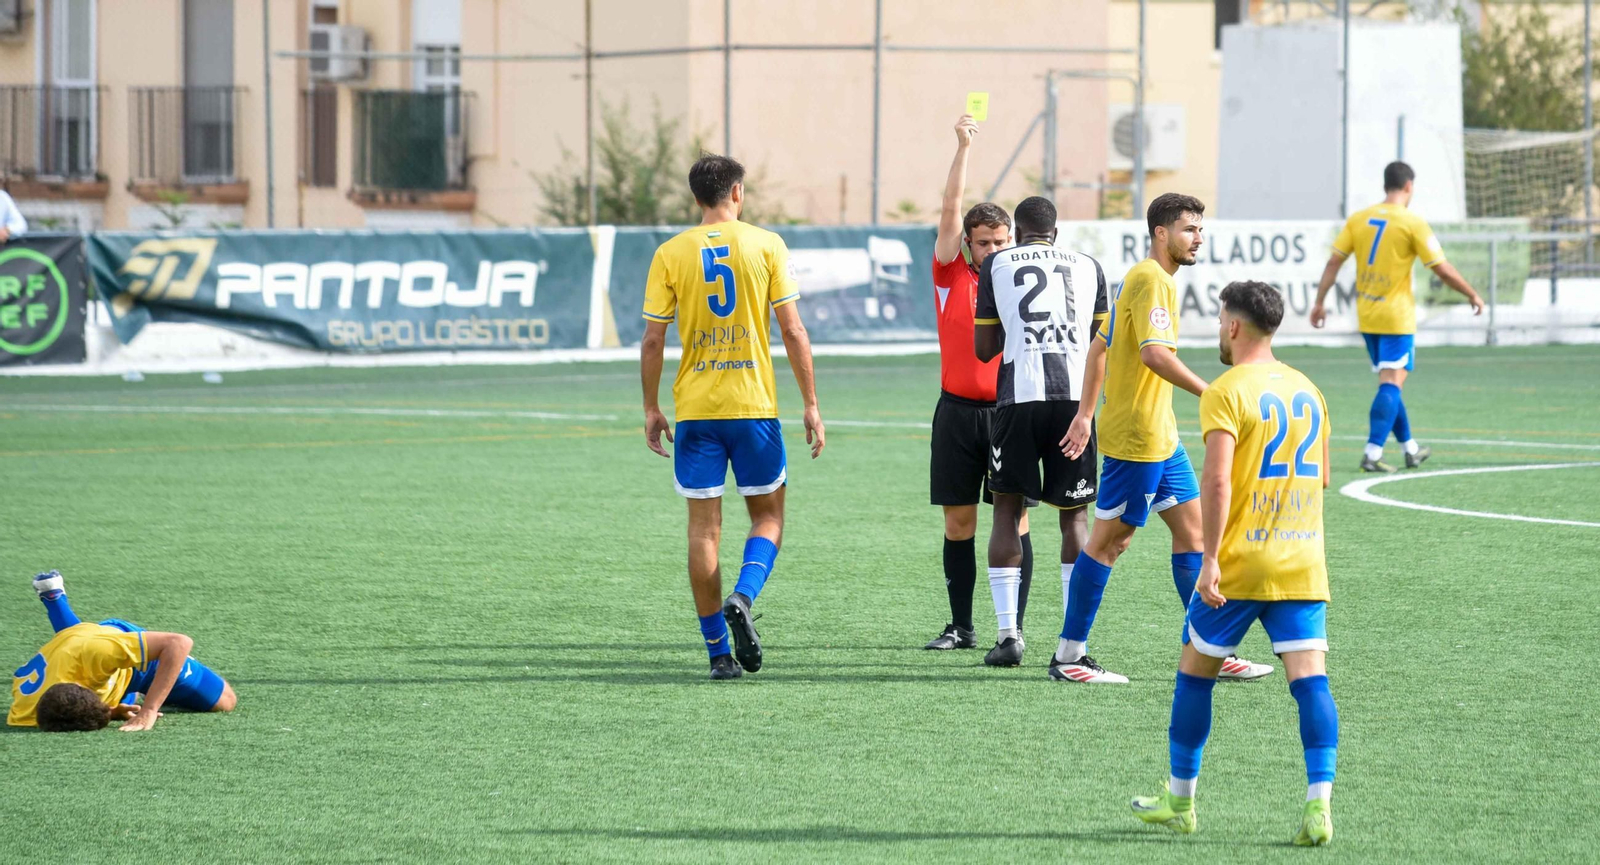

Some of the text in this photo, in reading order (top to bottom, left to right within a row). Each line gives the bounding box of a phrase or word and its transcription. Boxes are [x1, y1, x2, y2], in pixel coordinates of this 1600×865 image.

[1010, 249, 1077, 264] BOATENG
[1122, 233, 1306, 264] RLADOS
[1368, 217, 1388, 266] 7
[215, 259, 540, 310] PANTOJA
[700, 244, 737, 319] 5
[1013, 264, 1076, 324] 21
[327, 318, 414, 347] GRUPO
[709, 359, 758, 371] Tomares
[1258, 390, 1321, 480] 22
